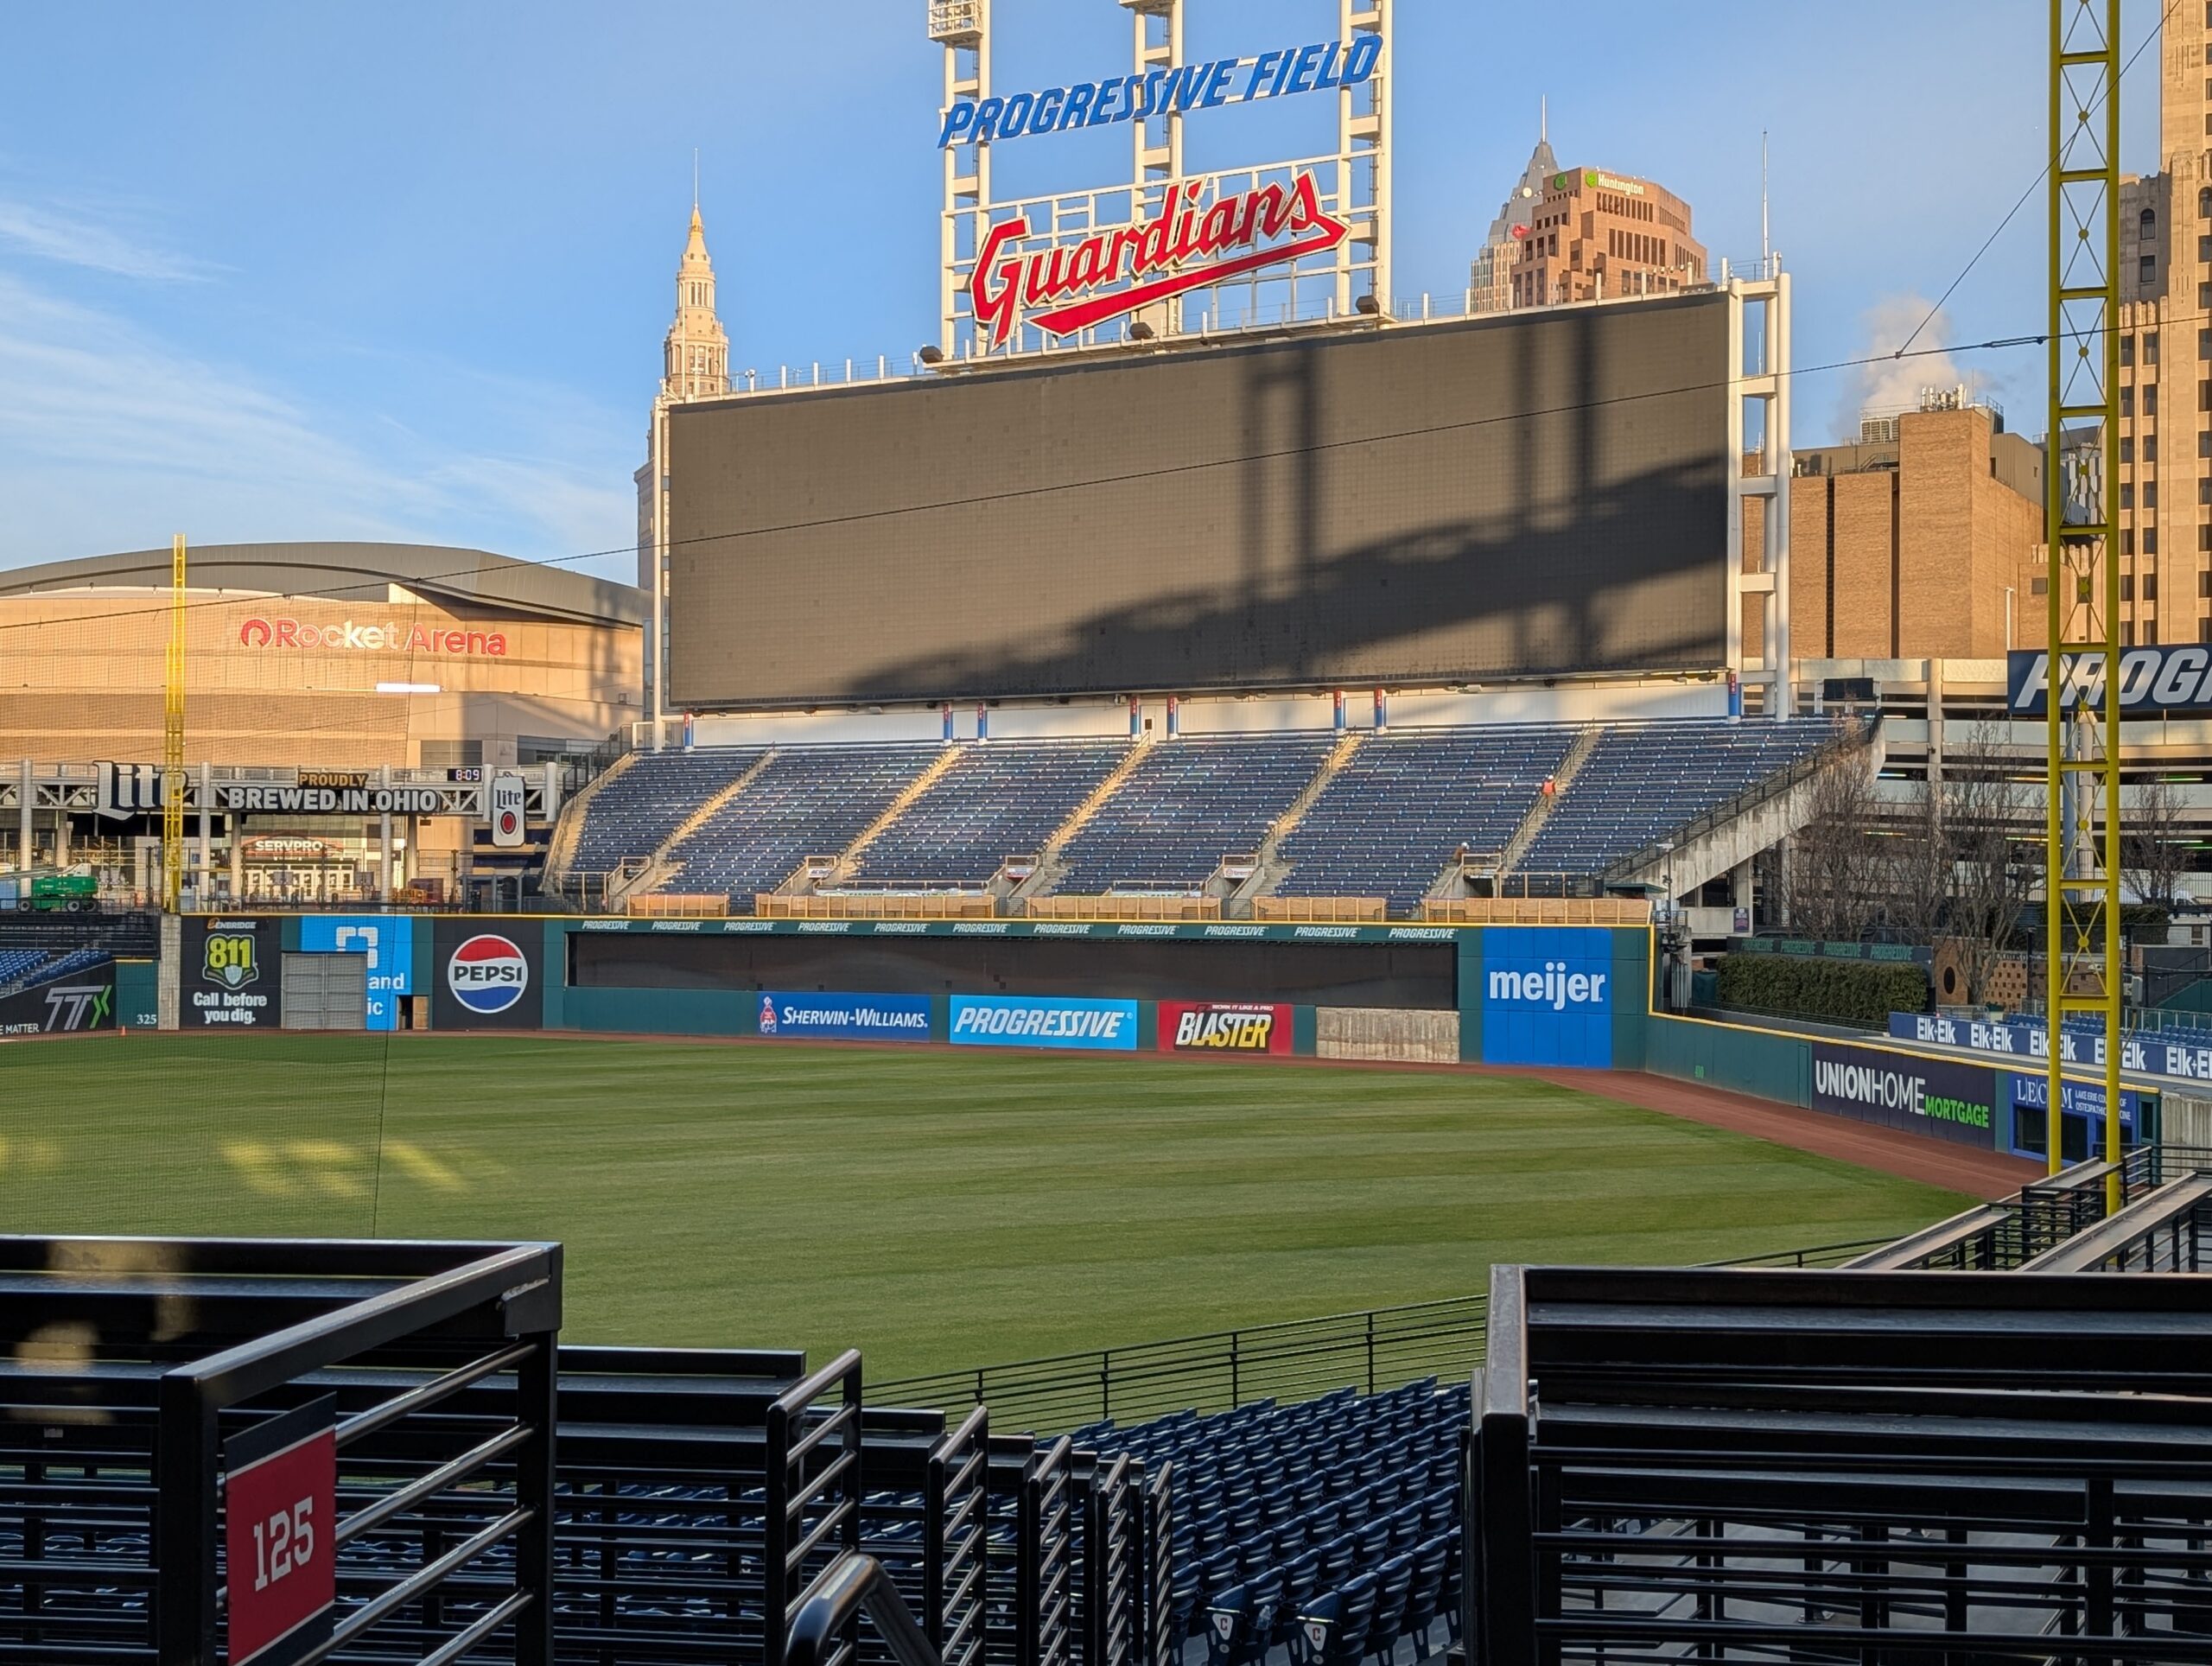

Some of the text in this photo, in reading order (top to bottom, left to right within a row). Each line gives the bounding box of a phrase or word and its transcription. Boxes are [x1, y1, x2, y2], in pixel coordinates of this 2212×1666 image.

[938, 34, 1384, 149] PROGRESSIVE FIELD
[1598, 173, 1644, 196] Huntington
[970, 169, 1351, 351] Guardians
[276, 618, 507, 656] Rocket Arena
[299, 773, 367, 787] PROUDLY
[455, 769, 480, 781] 8:09
[228, 787, 437, 812] BREWED IN OHIO
[495, 789, 522, 810] Lite
[255, 840, 323, 851] SERVPRO
[582, 920, 630, 930] PROGRESSIVE
[652, 921, 702, 931] PROGRESSIVE
[723, 922, 776, 932] PROGRESSIVE
[798, 922, 850, 932] PROGRESSIVE
[874, 923, 929, 932] PROGRESSIVE
[953, 924, 1008, 933] PROGRESSIVE
[1033, 924, 1091, 934] PROGRESSIVE
[1117, 925, 1177, 935] PROGRESSIVE
[1205, 925, 1267, 936] PROGRESSIVE
[1294, 926, 1358, 938] PROGRESSIVE
[1389, 928, 1455, 938] PROGRESSIVE
[209, 938, 251, 968] 811
[454, 965, 523, 982] PEPSI
[1490, 962, 1605, 1010] meijer
[193, 991, 267, 1007] Call before
[137, 1014, 157, 1025] 325
[205, 1008, 257, 1025] you dig.
[954, 1008, 1125, 1038] PROGRESSIVE
[5, 1023, 40, 1034] MATTER
[1916, 1017, 1956, 1045] Elk+Elk
[1971, 1023, 2013, 1052] Elk+Elk
[2075, 1090, 2087, 1100] LAKE
[2087, 1091, 2098, 1102] ERIE
[1925, 1095, 1989, 1129] MORTGAGE
[253, 1496, 314, 1592] 125
[1219, 1617, 1228, 1631] C
[1312, 1627, 1321, 1642] C
